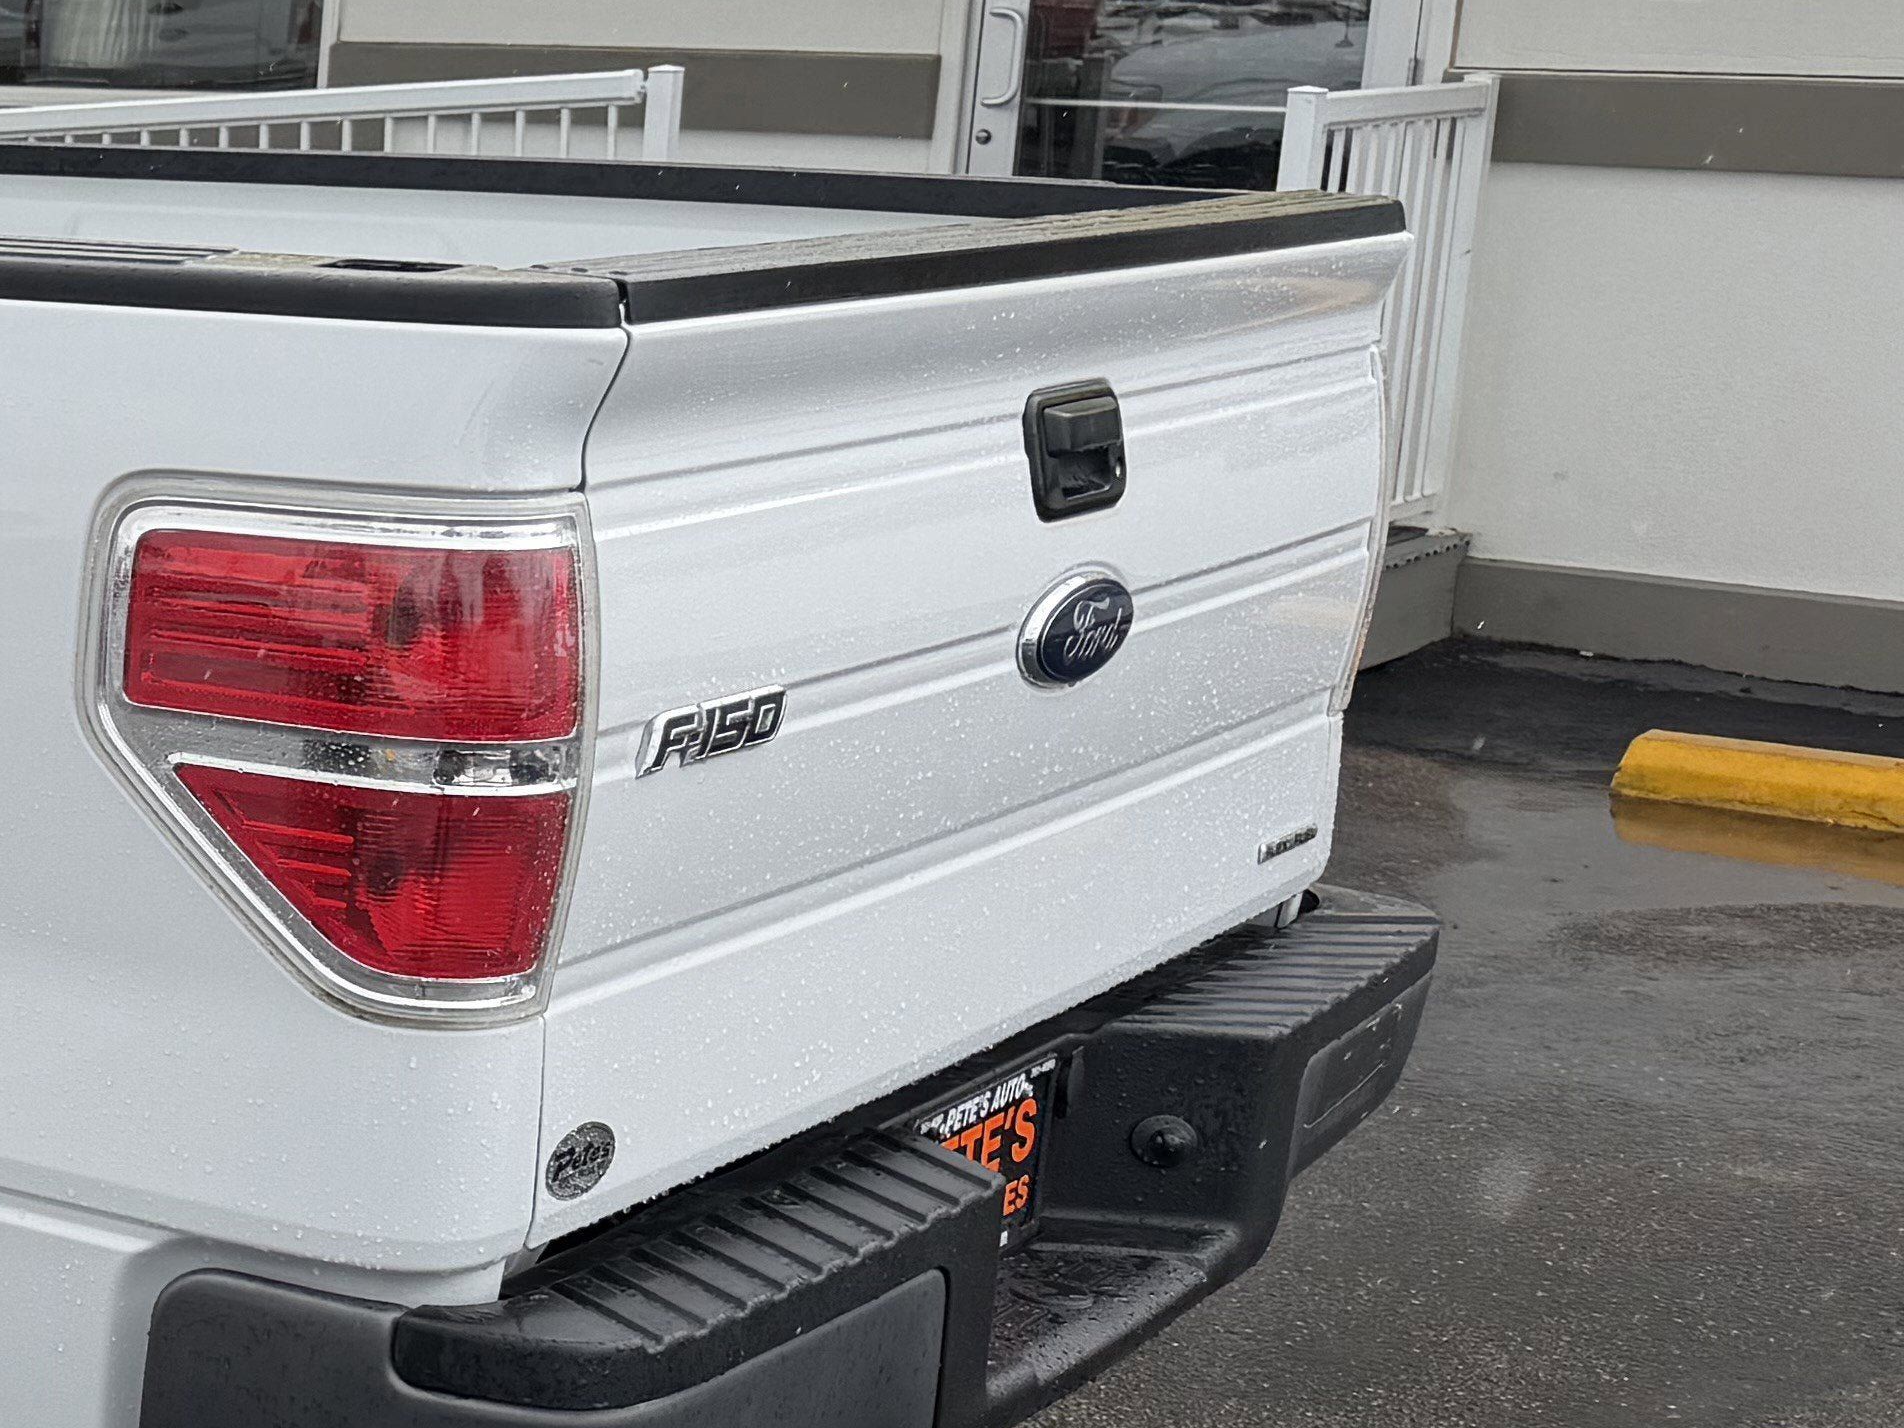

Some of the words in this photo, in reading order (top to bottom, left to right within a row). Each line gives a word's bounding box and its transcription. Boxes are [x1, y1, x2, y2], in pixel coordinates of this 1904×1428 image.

[1063, 596, 1123, 666] Ford
[944, 1090, 992, 1139] PETE'S
[990, 1073, 1027, 1113] AUTO
